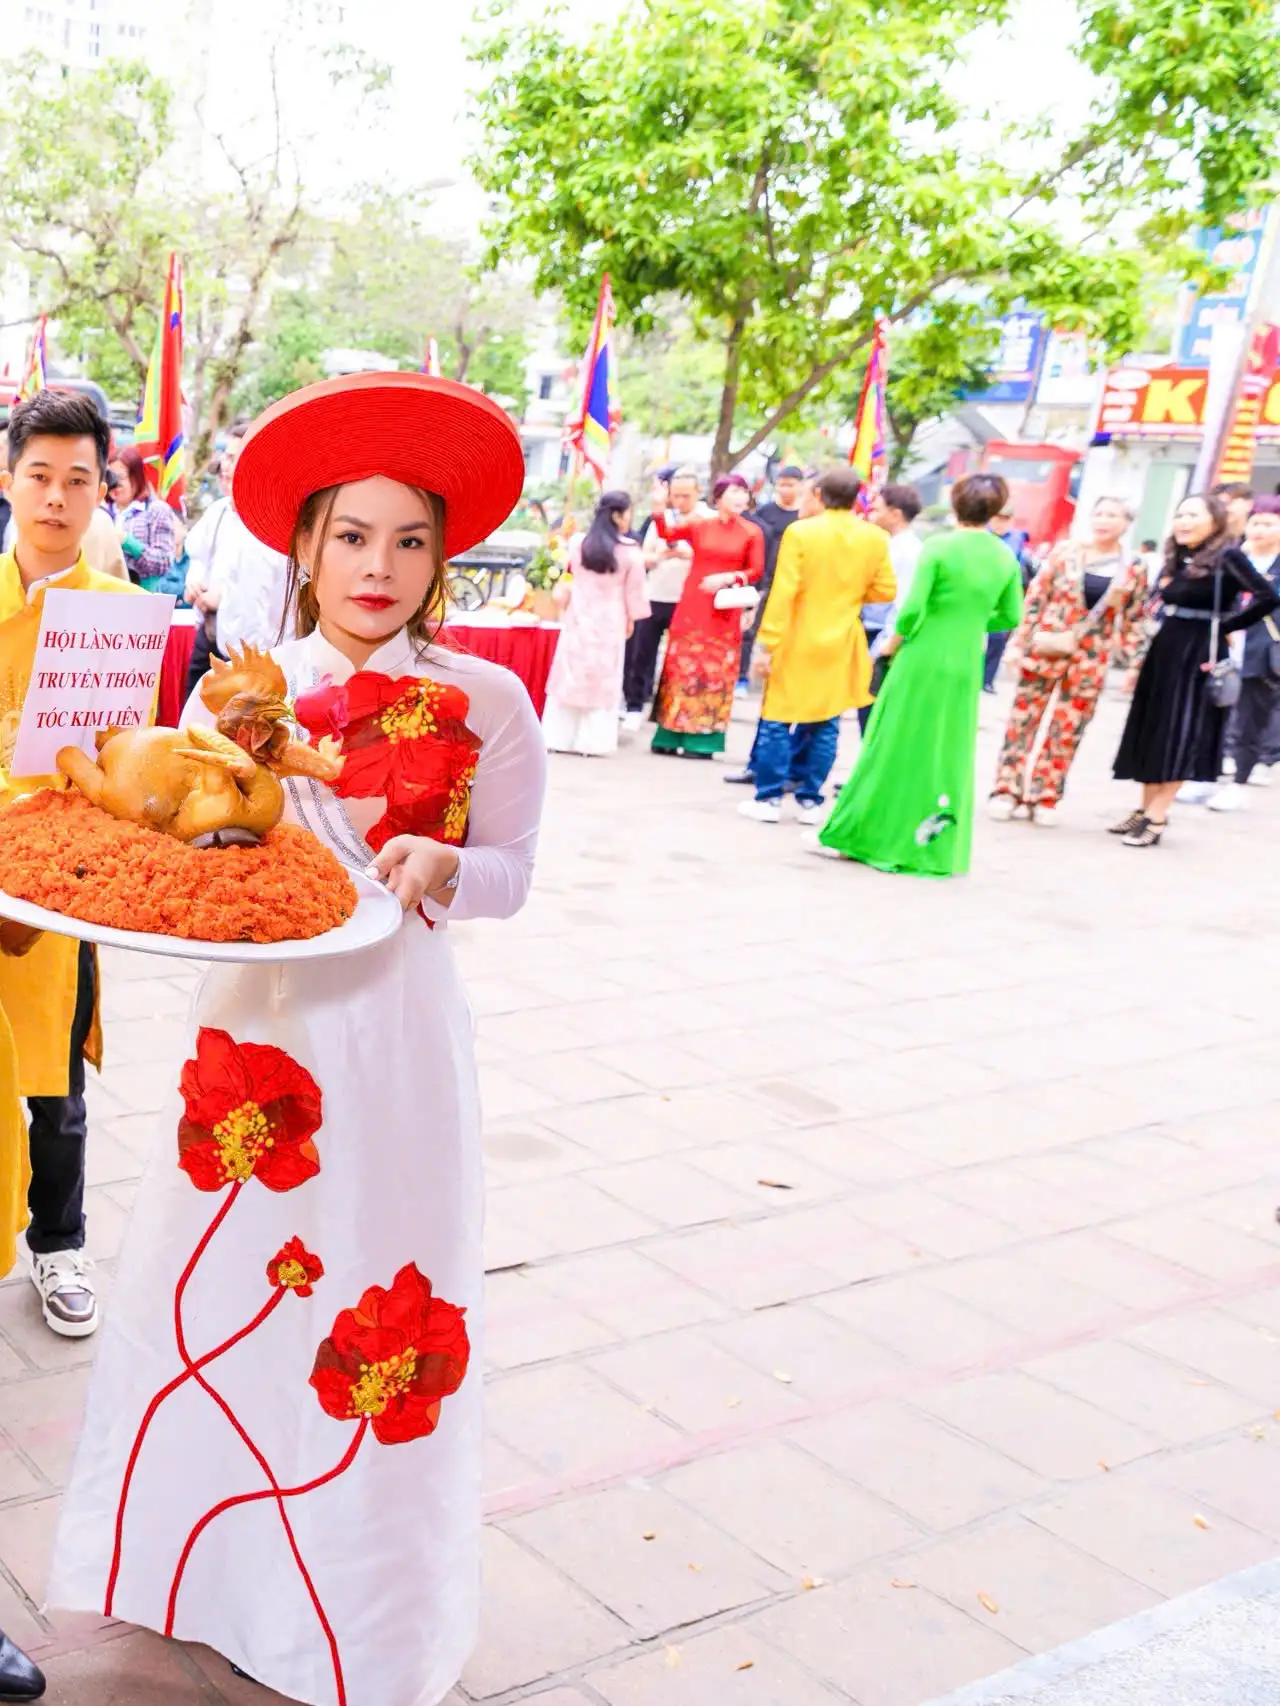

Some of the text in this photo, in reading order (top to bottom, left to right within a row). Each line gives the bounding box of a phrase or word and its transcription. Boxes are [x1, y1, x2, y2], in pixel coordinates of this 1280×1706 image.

[44, 630, 78, 652] HỘI
[80, 628, 123, 650] LÀNG
[106, 668, 156, 689] THỐNG
[37, 706, 143, 729] TÓC KIM LIÊN
